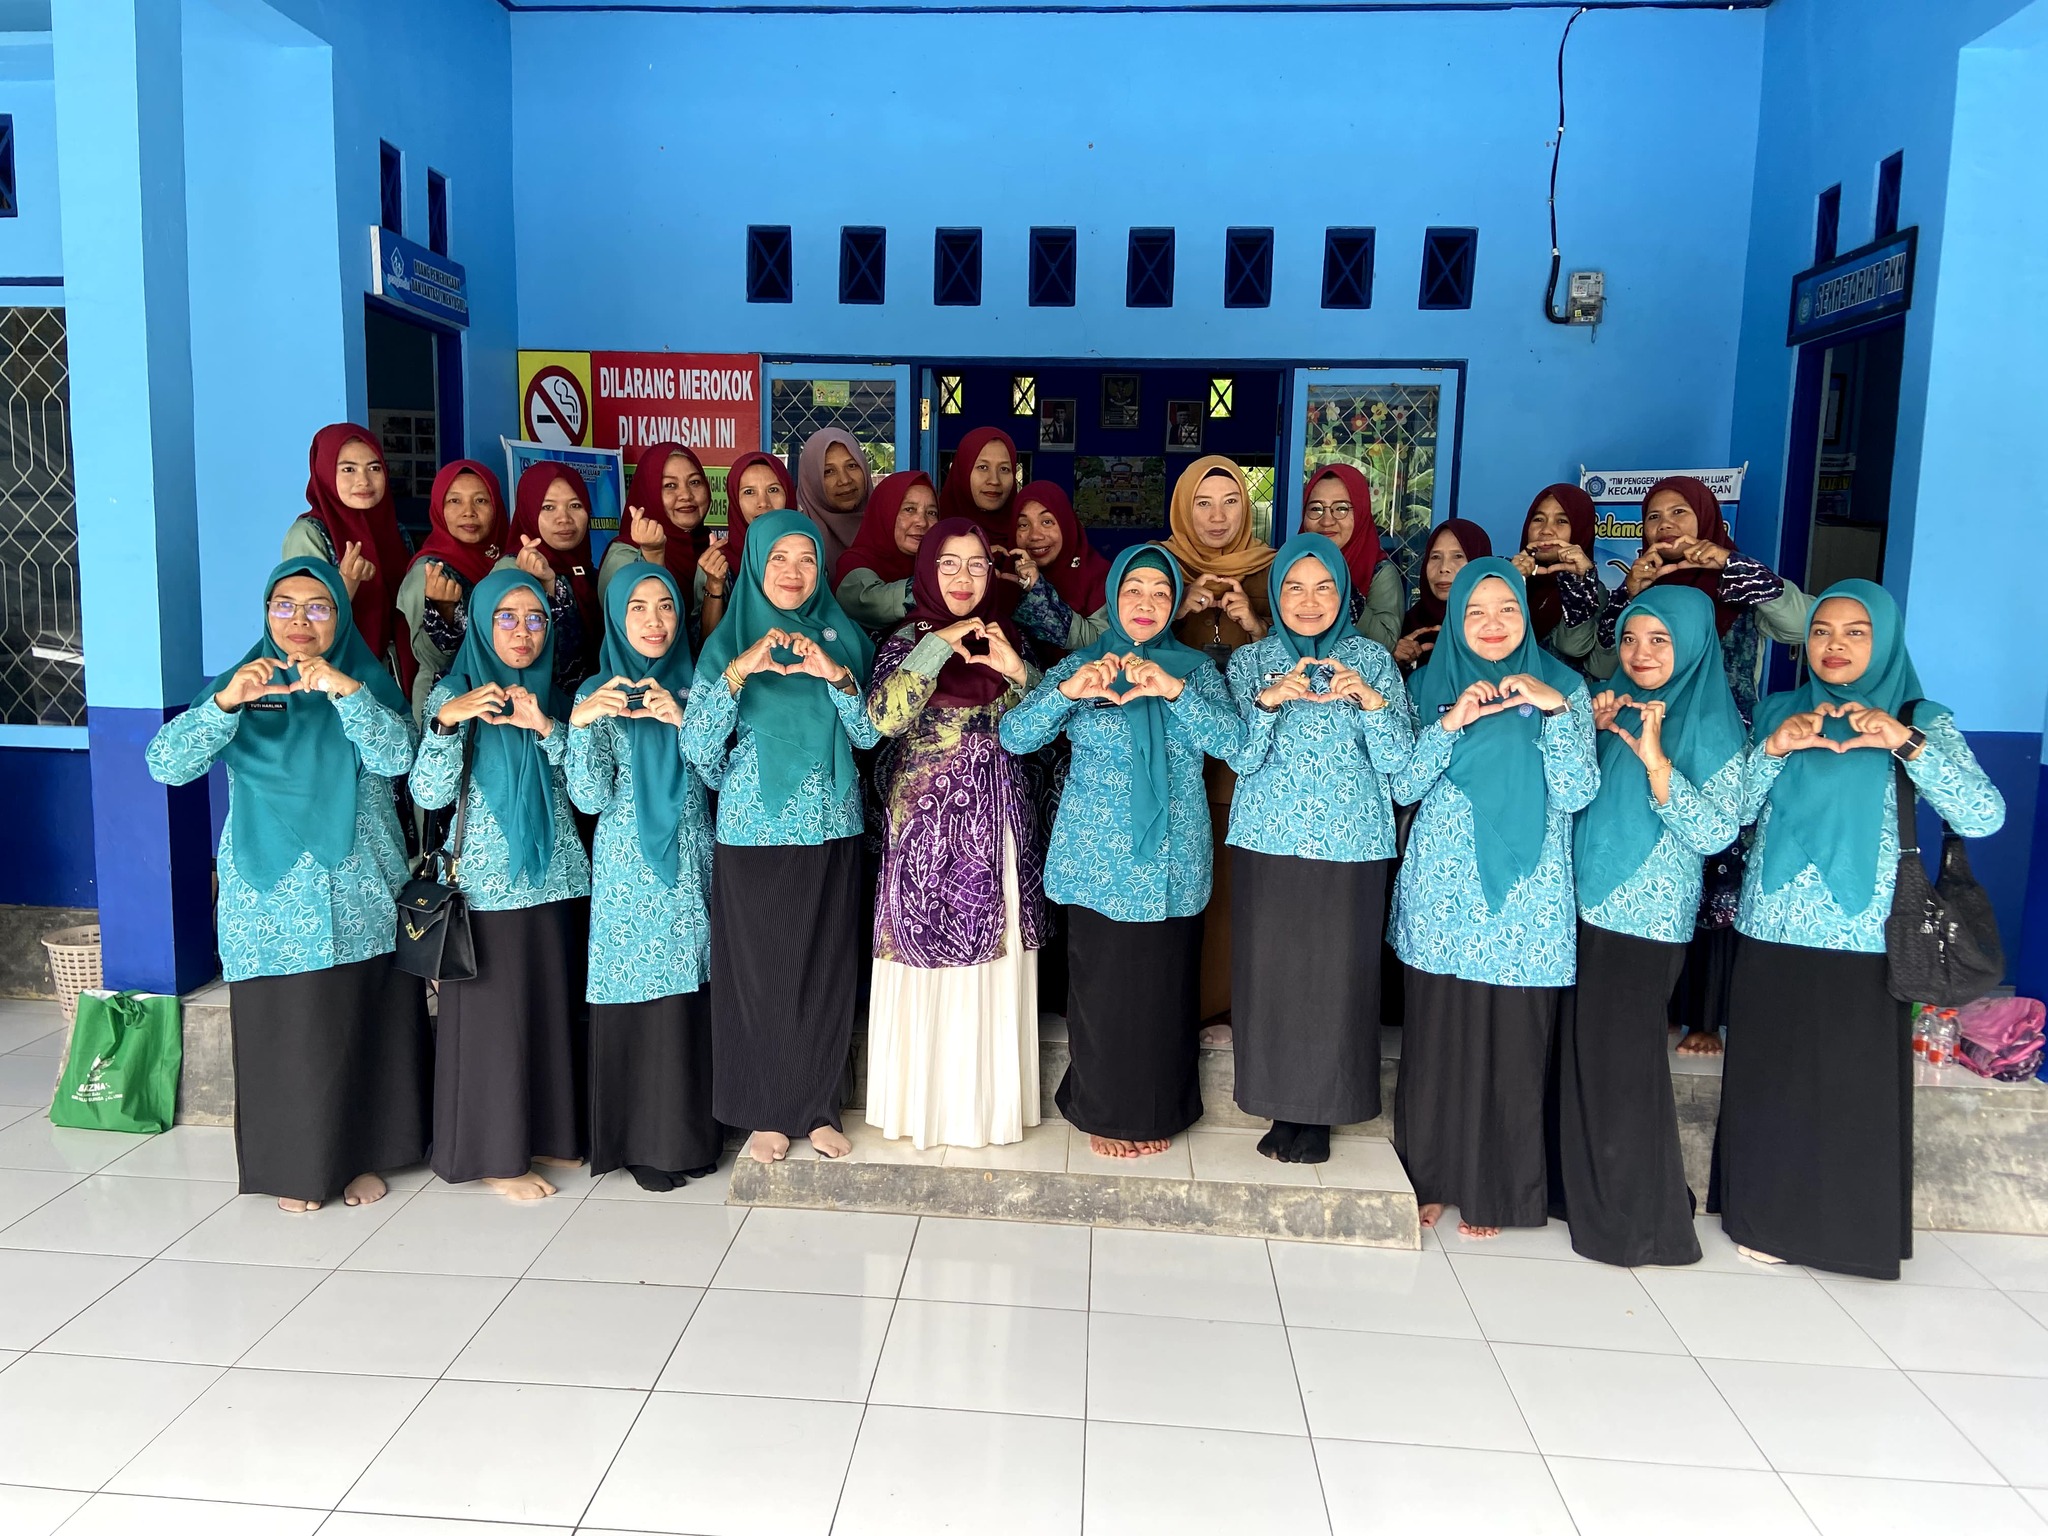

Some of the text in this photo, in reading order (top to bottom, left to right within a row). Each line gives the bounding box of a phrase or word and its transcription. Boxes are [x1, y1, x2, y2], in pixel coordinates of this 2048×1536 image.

[1815, 252, 1906, 318] SEKRETARIAT PKK
[600, 367, 753, 401] DILARANG MEROKOK
[618, 416, 736, 449] DI KAWASAN INI
[1608, 486, 1651, 496] KECAMA
[709, 499, 727, 516] 2015
[591, 519, 618, 529] KELUARGA
[1594, 513, 1644, 538] elama
